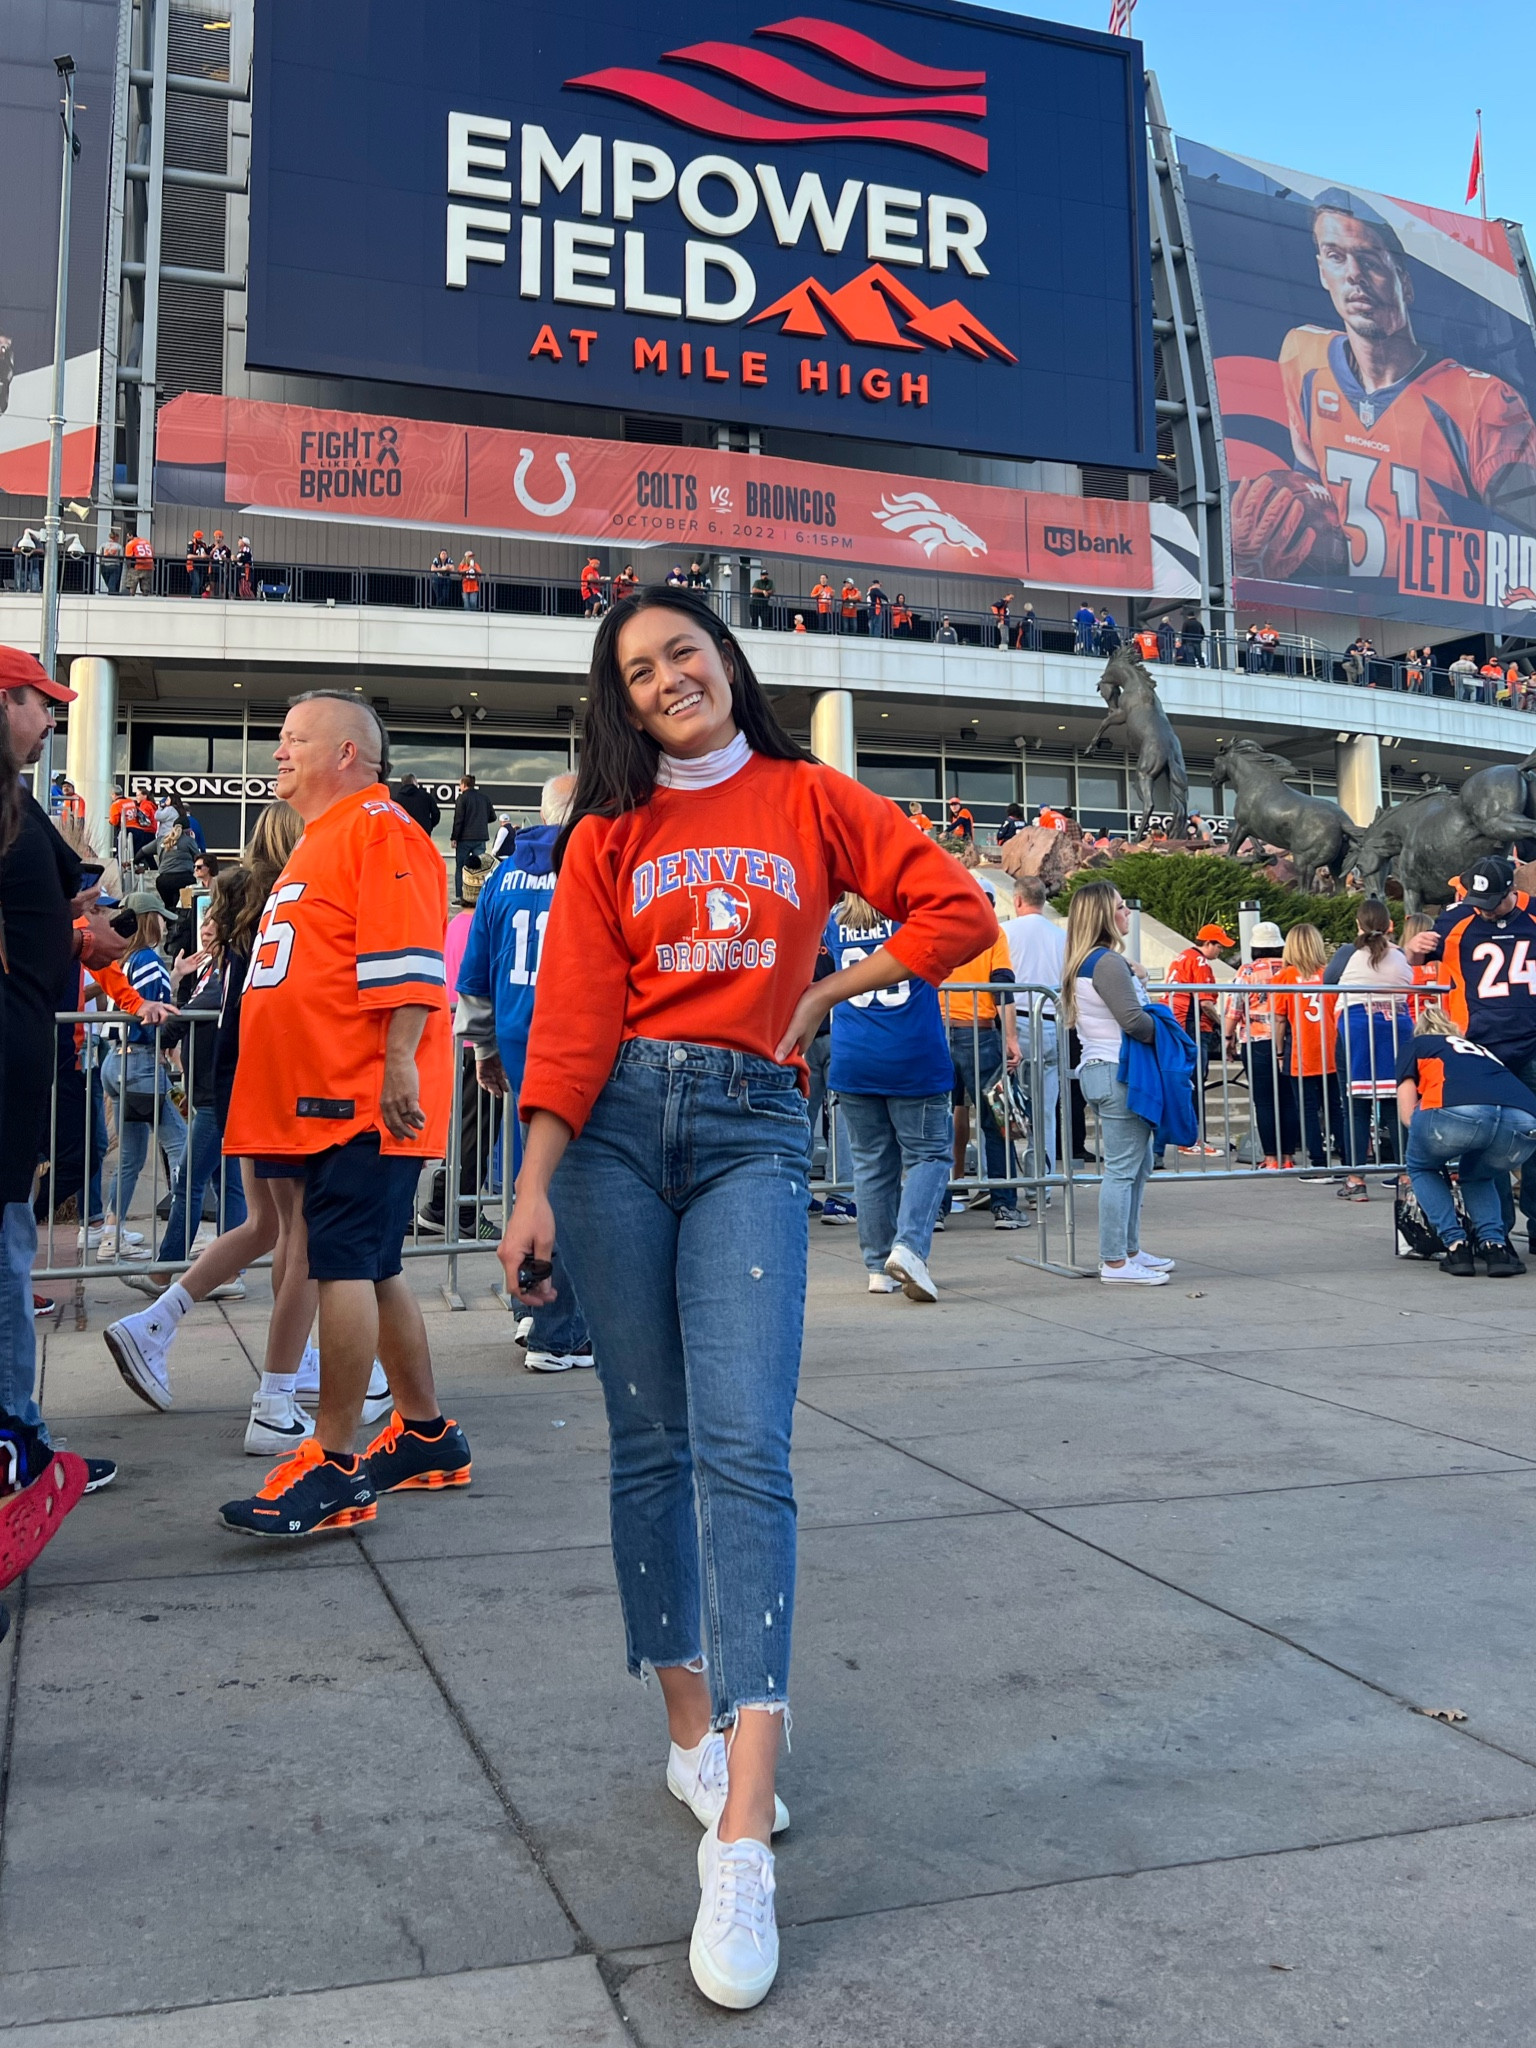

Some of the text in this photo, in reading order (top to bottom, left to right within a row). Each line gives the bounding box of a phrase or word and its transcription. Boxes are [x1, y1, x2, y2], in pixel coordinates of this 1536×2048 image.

[446, 110, 990, 277] EMPOWER
[445, 203, 757, 326] FIELD
[528, 324, 930, 407] AT MILE HIGH
[300, 427, 375, 464] FIGHT
[1344, 433, 1391, 453] BRONCOS
[320, 460, 362, 468] LIKE A
[300, 468, 402, 502] BRONCO
[636, 470, 698, 511] COLTS
[746, 481, 837, 528] BRONCOS
[612, 514, 854, 549] OCTOBER 6, 2022 6:15PM
[1078, 529, 1134, 555] bank
[1404, 522, 1481, 599] LET'S
[500, 869, 559, 892] PITTMAN
[632, 847, 800, 918] DENVER
[656, 938, 777, 973] BRONCOS
[1472, 940, 1536, 999] 24
[288, 1520, 301, 1531] 59
